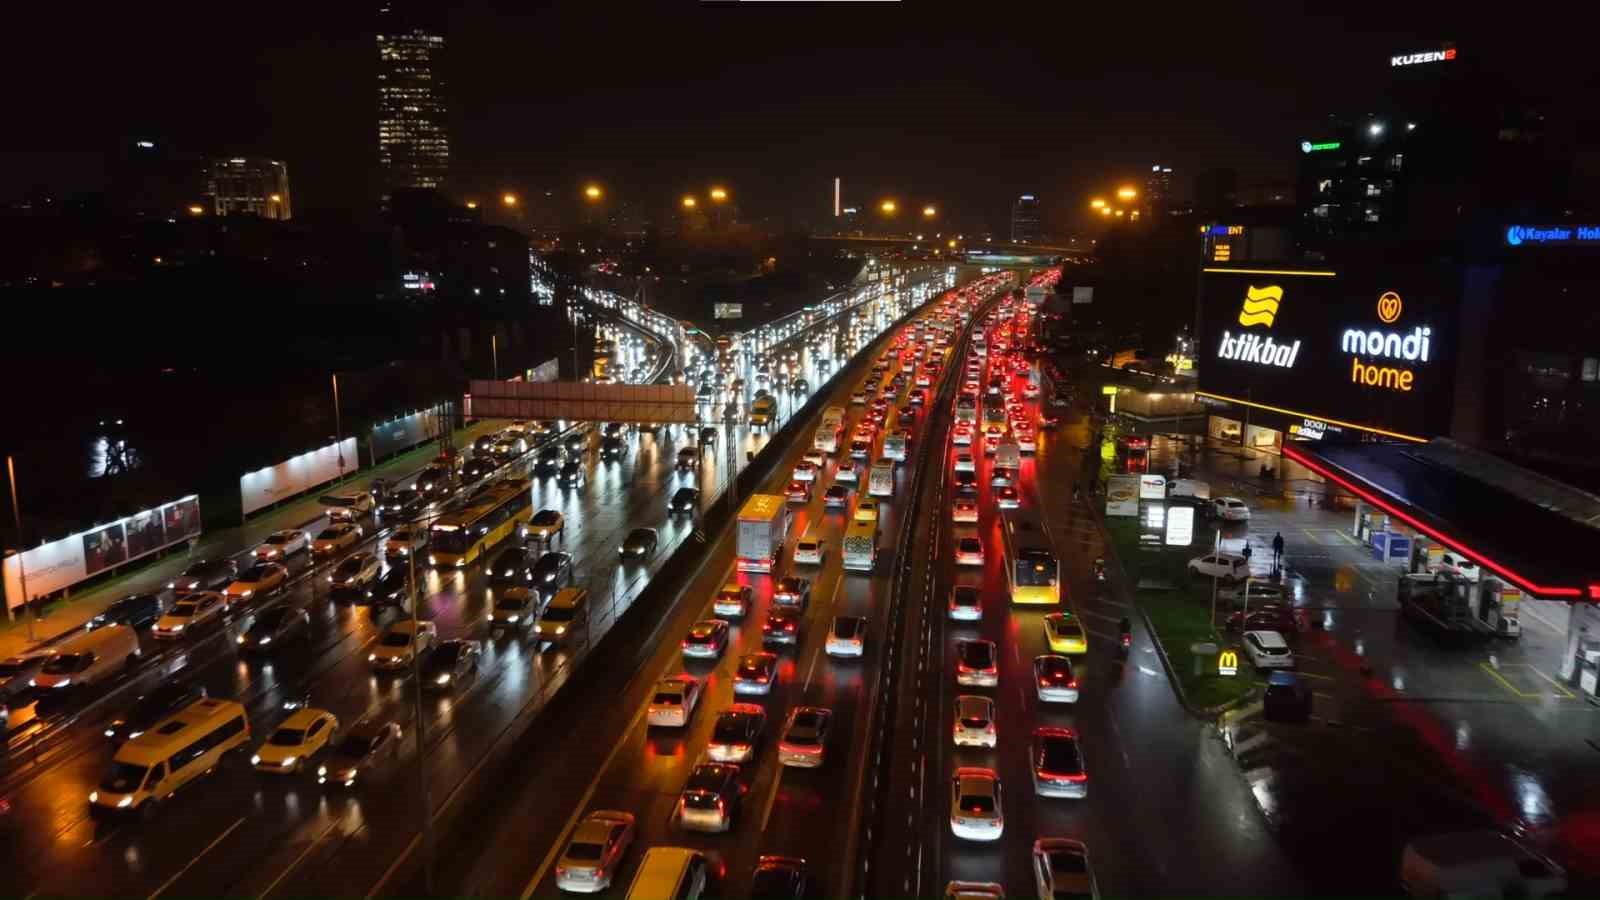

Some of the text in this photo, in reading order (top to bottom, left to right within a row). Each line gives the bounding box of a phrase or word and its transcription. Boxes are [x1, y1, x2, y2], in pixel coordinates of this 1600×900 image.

[1526, 226, 1569, 243] Kayalar
[1218, 331, 1301, 368] istikbal
[1342, 326, 1432, 362] mondi
[1352, 357, 1413, 391] home
